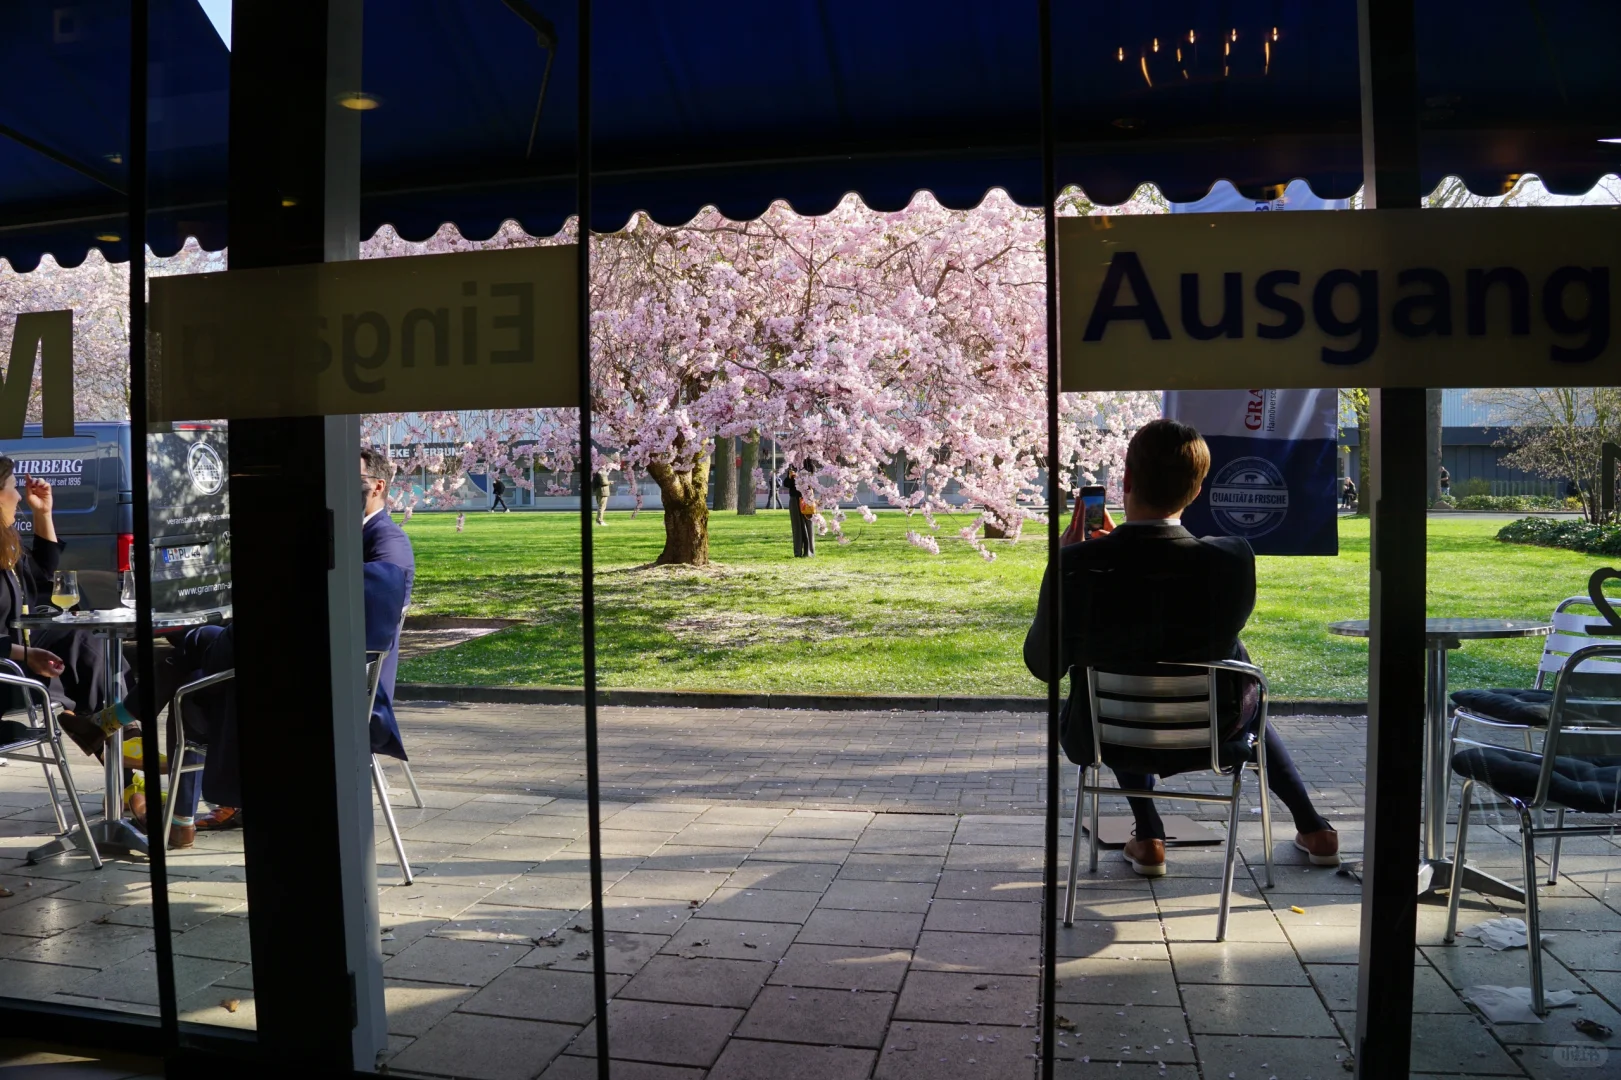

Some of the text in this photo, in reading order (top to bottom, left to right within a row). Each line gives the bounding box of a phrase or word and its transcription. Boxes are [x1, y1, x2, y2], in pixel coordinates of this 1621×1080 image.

[1082, 251, 1610, 366] Ausgang
[1212, 492, 1248, 503] QUALITÄT
[1254, 494, 1287, 504] FRISCHE
